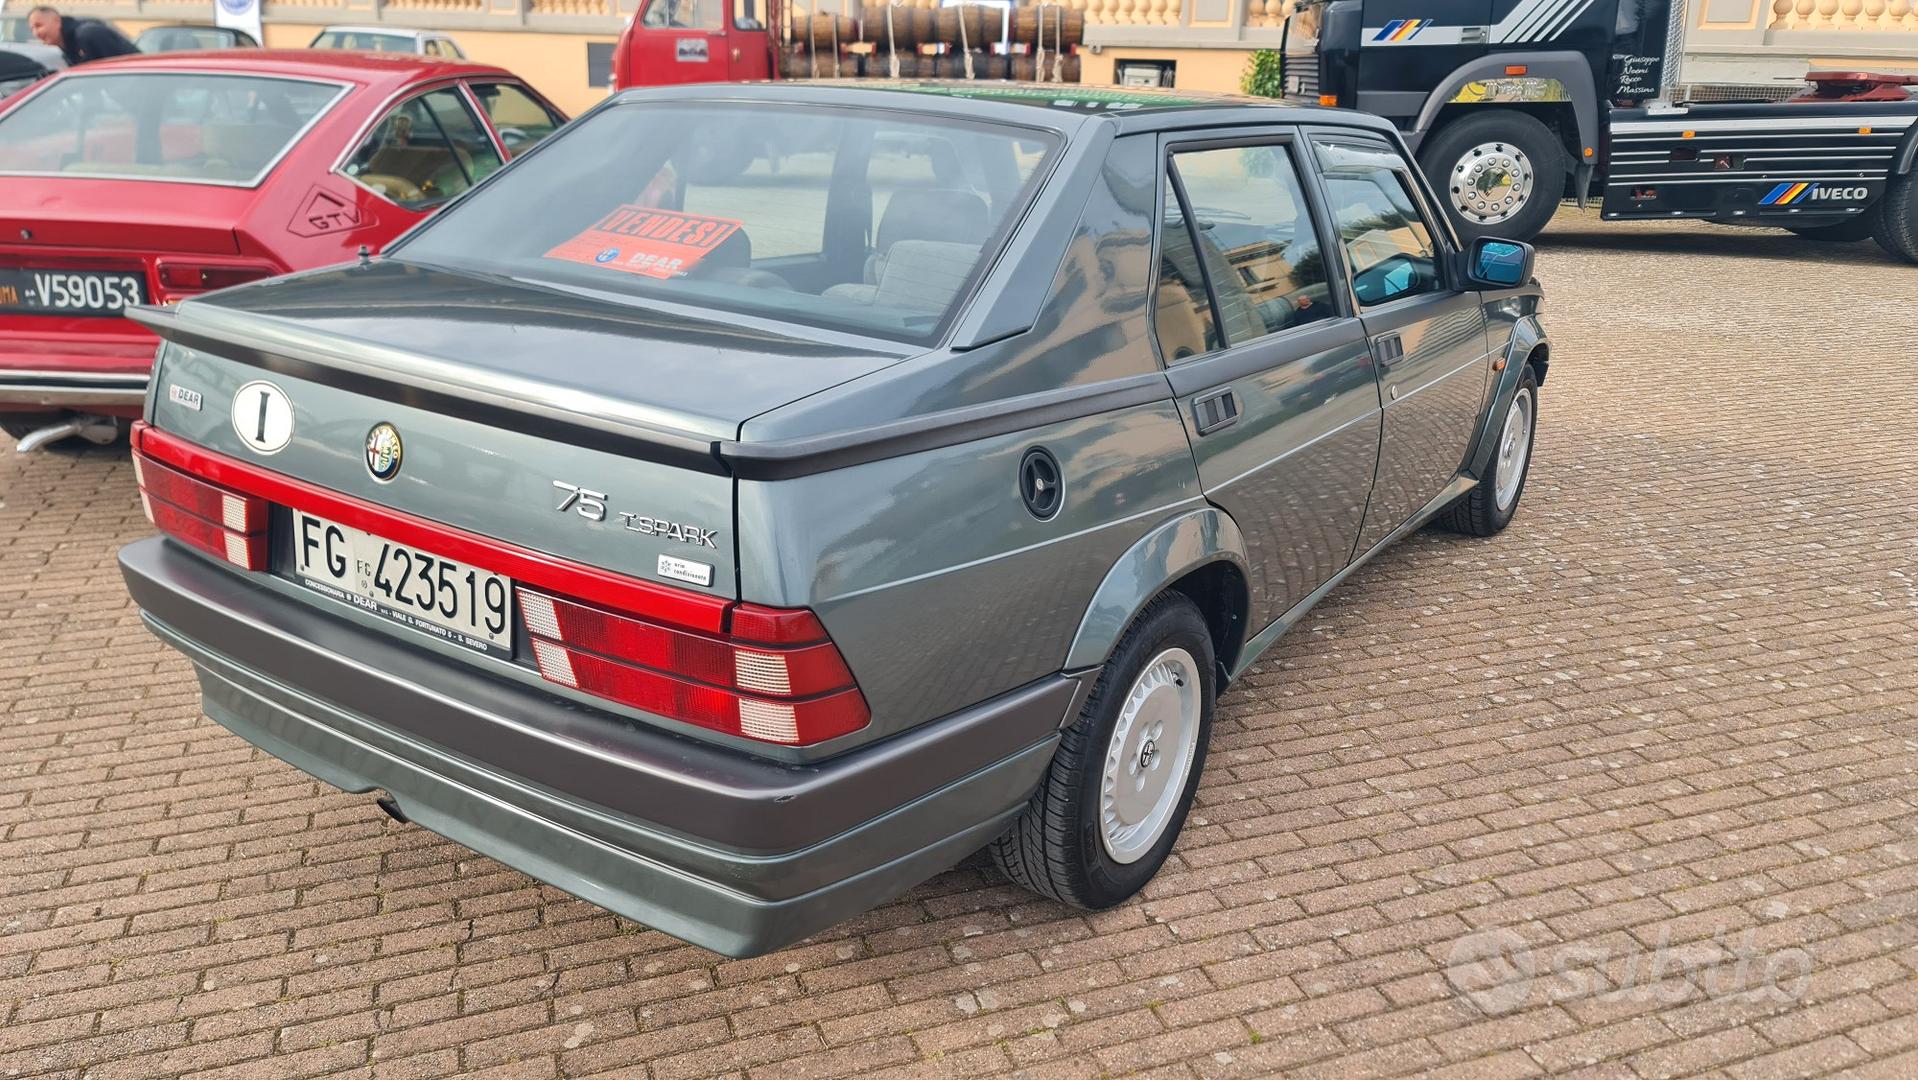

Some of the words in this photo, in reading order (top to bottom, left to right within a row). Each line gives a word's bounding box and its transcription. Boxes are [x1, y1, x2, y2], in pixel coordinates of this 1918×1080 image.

[1616, 85, 1655, 94] Massimo
[1811, 187, 1868, 200] IVECO
[308, 207, 360, 230] GTV
[602, 208, 728, 248] VENDESI
[628, 252, 684, 270] DEAR
[34, 273, 141, 309] V59053
[178, 389, 200, 405] DEAR
[256, 391, 271, 443] I
[552, 480, 608, 521] 75
[302, 515, 347, 578] FG
[374, 544, 506, 635] 423519
[357, 560, 371, 577] FG
[353, 594, 377, 611] DEAR
[392, 610, 407, 622] VIALE
[415, 619, 446, 636] FORTUNATO
[465, 637, 488, 651] SEVERO
